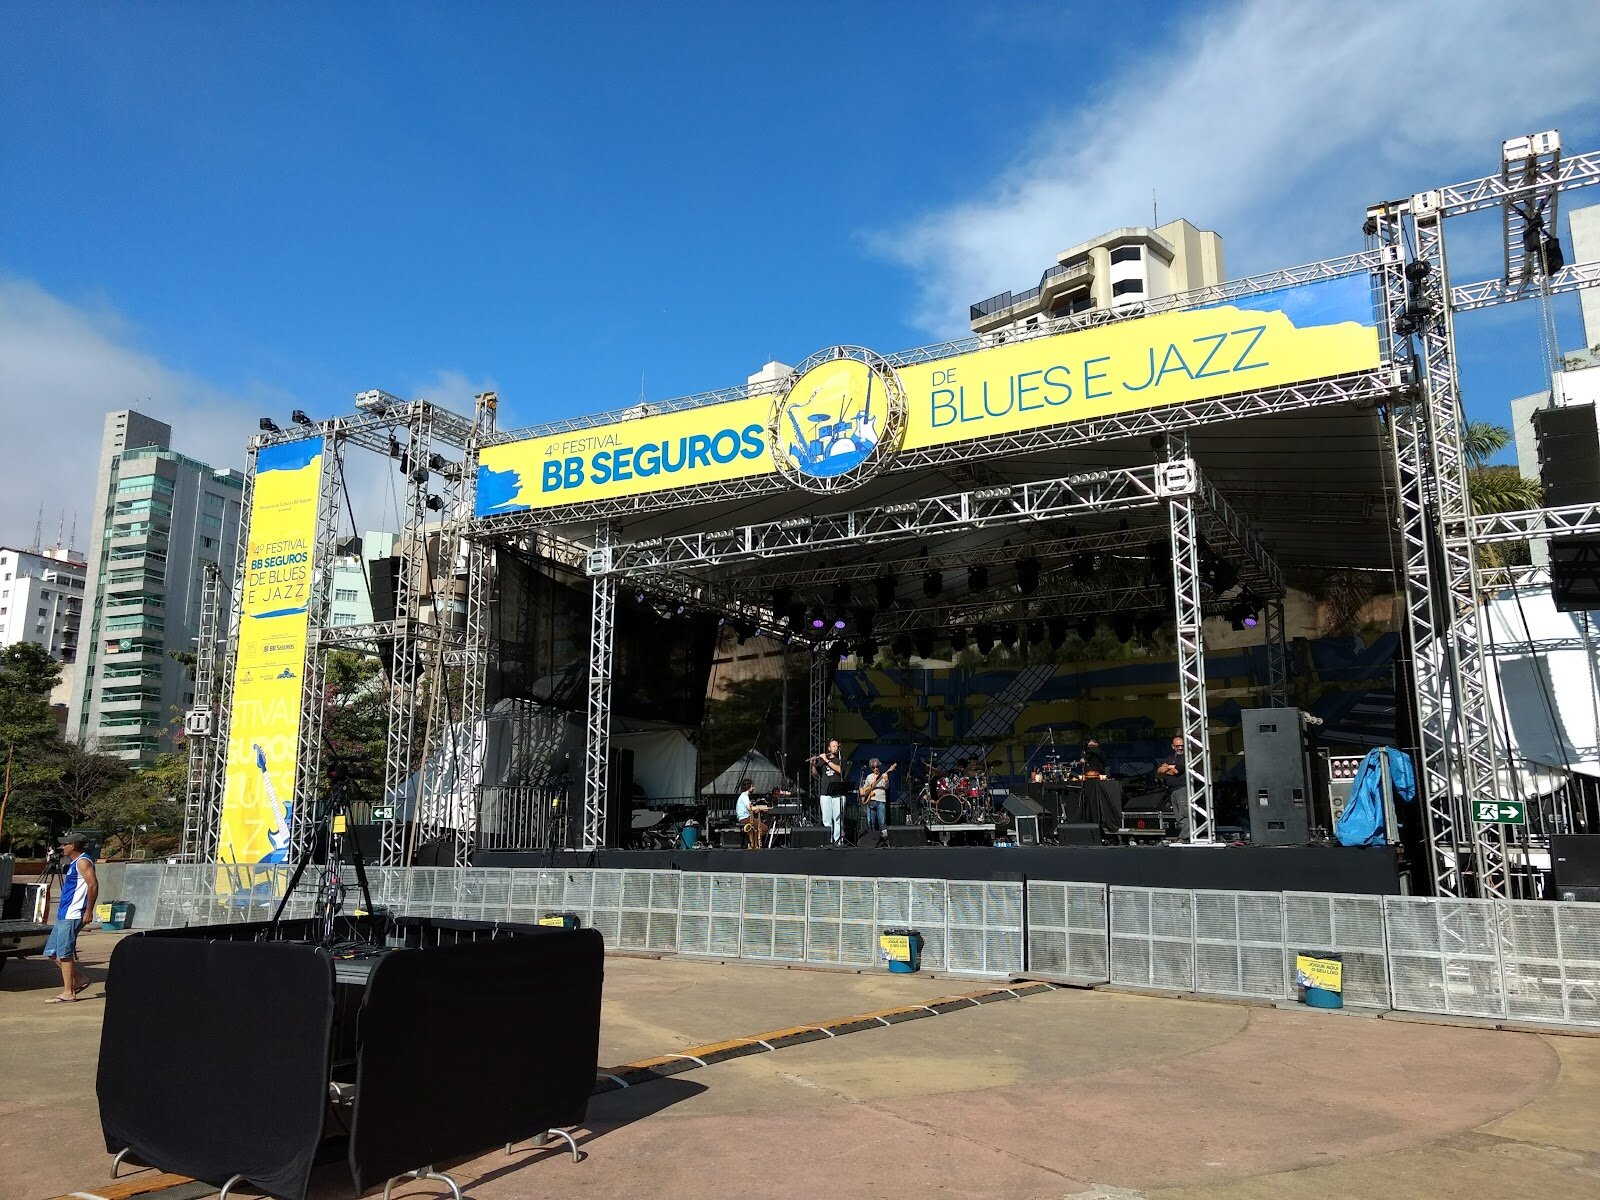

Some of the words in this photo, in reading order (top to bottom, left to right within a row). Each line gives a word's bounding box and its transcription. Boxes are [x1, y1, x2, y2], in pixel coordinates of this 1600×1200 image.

[931, 365, 1073, 428] BLUES
[1084, 356, 1113, 400] E
[1122, 324, 1270, 392] JAZZ
[932, 367, 958, 387] DE
[562, 433, 623, 455] FESTIVAL
[541, 456, 585, 492] BB
[590, 424, 765, 485] SEGUROS
[266, 538, 308, 555] FESTIVAL
[251, 559, 263, 570] BB
[264, 551, 308, 568] SEGUROS
[250, 571, 266, 587] DE
[269, 565, 307, 584] BLUES
[248, 590, 256, 604] E
[263, 583, 305, 602] JAZZ
